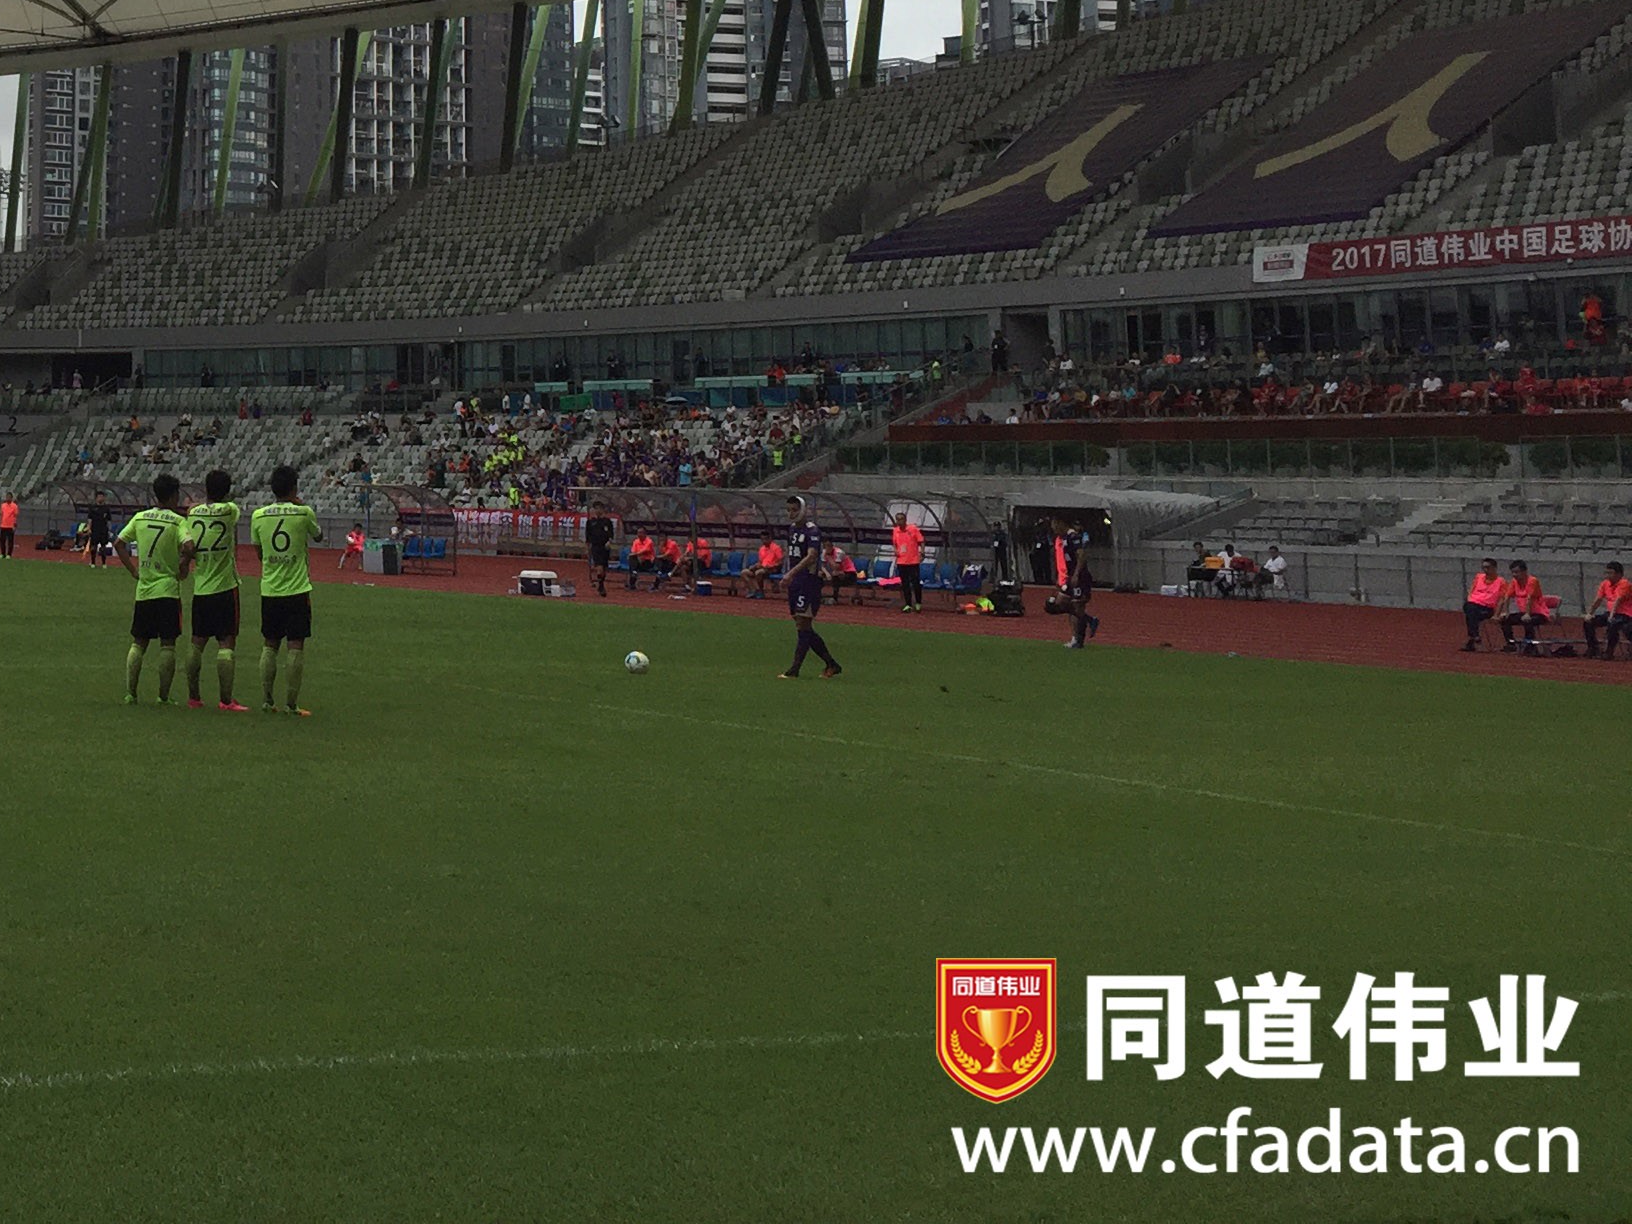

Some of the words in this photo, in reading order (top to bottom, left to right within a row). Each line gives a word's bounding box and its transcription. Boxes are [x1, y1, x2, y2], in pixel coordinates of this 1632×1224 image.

[8, 416, 17, 432] 2
[147, 524, 165, 558] 7
[191, 519, 228, 552] 22
[271, 518, 291, 553] 6
[796, 595, 805, 608] 5
